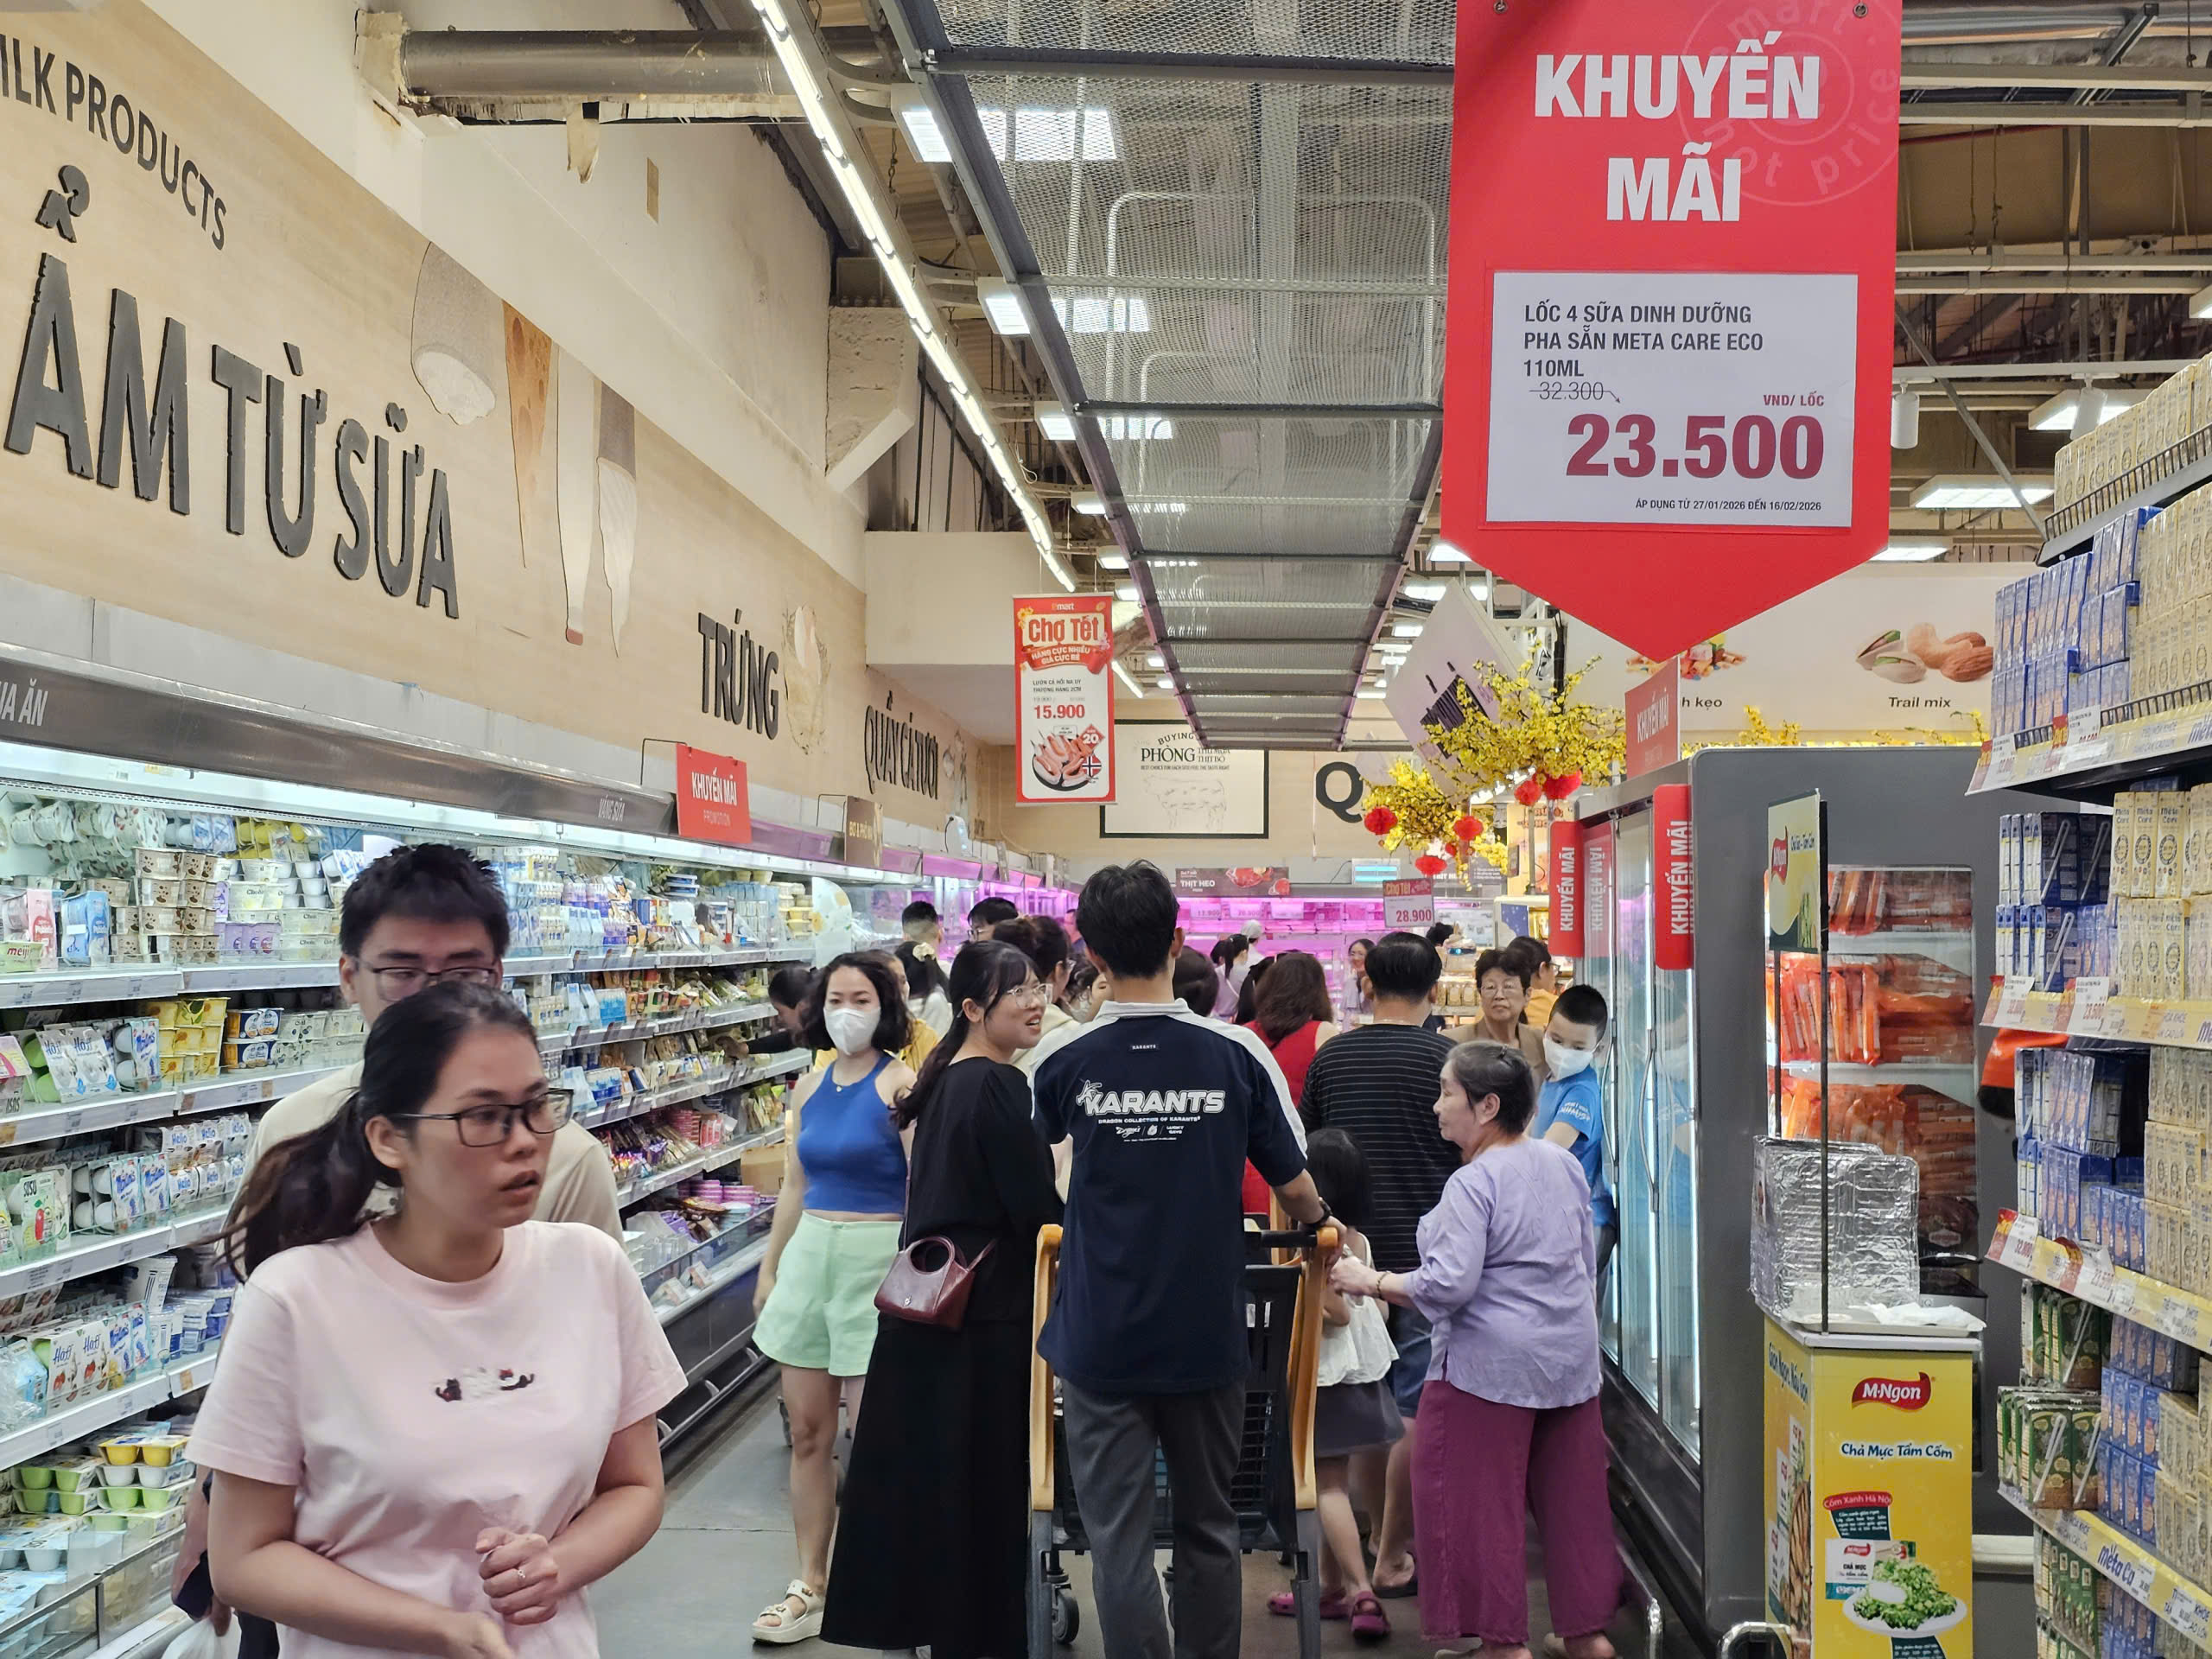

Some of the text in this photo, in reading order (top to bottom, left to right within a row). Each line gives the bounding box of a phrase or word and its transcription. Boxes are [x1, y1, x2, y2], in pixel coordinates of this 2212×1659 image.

[1535, 30, 1820, 119] KHUYẾN
[66, 61, 226, 251] PRODUCTS
[1606, 142, 1741, 222] MÃI
[1525, 299, 1751, 323] LỐC 4 SỮA DINH DƯỠNG
[1524, 325, 1763, 351] PHA SẴN META CARE ECO
[1523, 359, 1584, 377] 110ML
[1539, 381, 1604, 400] 32.300
[1763, 391, 1825, 407] VND/ LỐC
[1566, 413, 1824, 480] 23.500
[212, 341, 327, 558] TỪ
[335, 402, 459, 620] SỮA
[1636, 498, 1821, 512] ÁP DỤNG TỪ 27/01/2026 ĐẾN 16/02/2026
[1028, 614, 1099, 645] Chợ Tết
[698, 608, 779, 741] TRỨNG
[18, 677, 48, 727] ĂN
[1033, 704, 1085, 719] 15.900
[1695, 696, 1723, 710] kẹo
[1888, 696, 1951, 708] Trail mix
[1083, 734, 1099, 744] 20
[1141, 745, 1196, 763] PHÒNG
[691, 767, 737, 806] KHUYẾN MÃI
[1180, 880, 1198, 889] THỊT
[1665, 820, 1688, 935] KHUYẾN MÃI
[1557, 846, 1575, 931] KHUYẾN MÃI
[1396, 909, 1432, 923] 28.900
[7, 944, 30, 957] meiji
[1077, 1080, 1225, 1116] KARANTS
[1841, 1443, 1865, 1457] Chả
[1868, 1445, 1894, 1460] Mực
[1925, 1445, 1953, 1459] Cốm
[1844, 1494, 1864, 1504] Xanh
[1866, 1493, 1877, 1503] Hà
